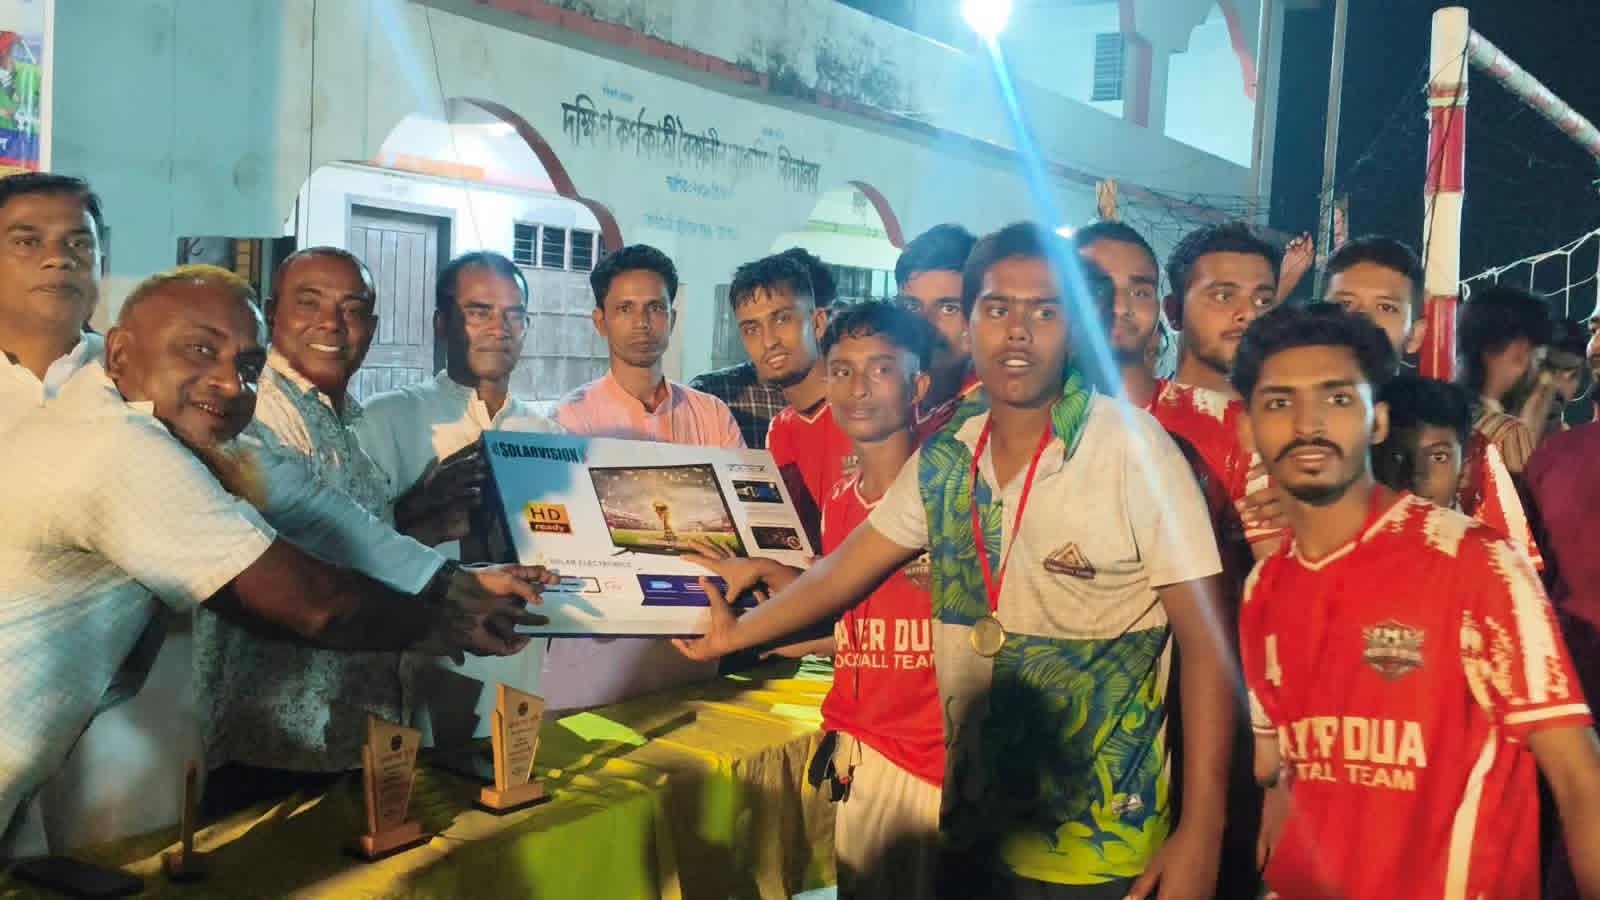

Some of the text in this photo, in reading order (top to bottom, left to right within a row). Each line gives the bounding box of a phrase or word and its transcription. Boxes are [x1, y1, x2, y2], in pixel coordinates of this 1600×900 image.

[530, 507, 561, 521] HD
[894, 618, 935, 653] DU
[1343, 716, 1427, 768] DUA
[1343, 763, 1416, 791] TEAM
